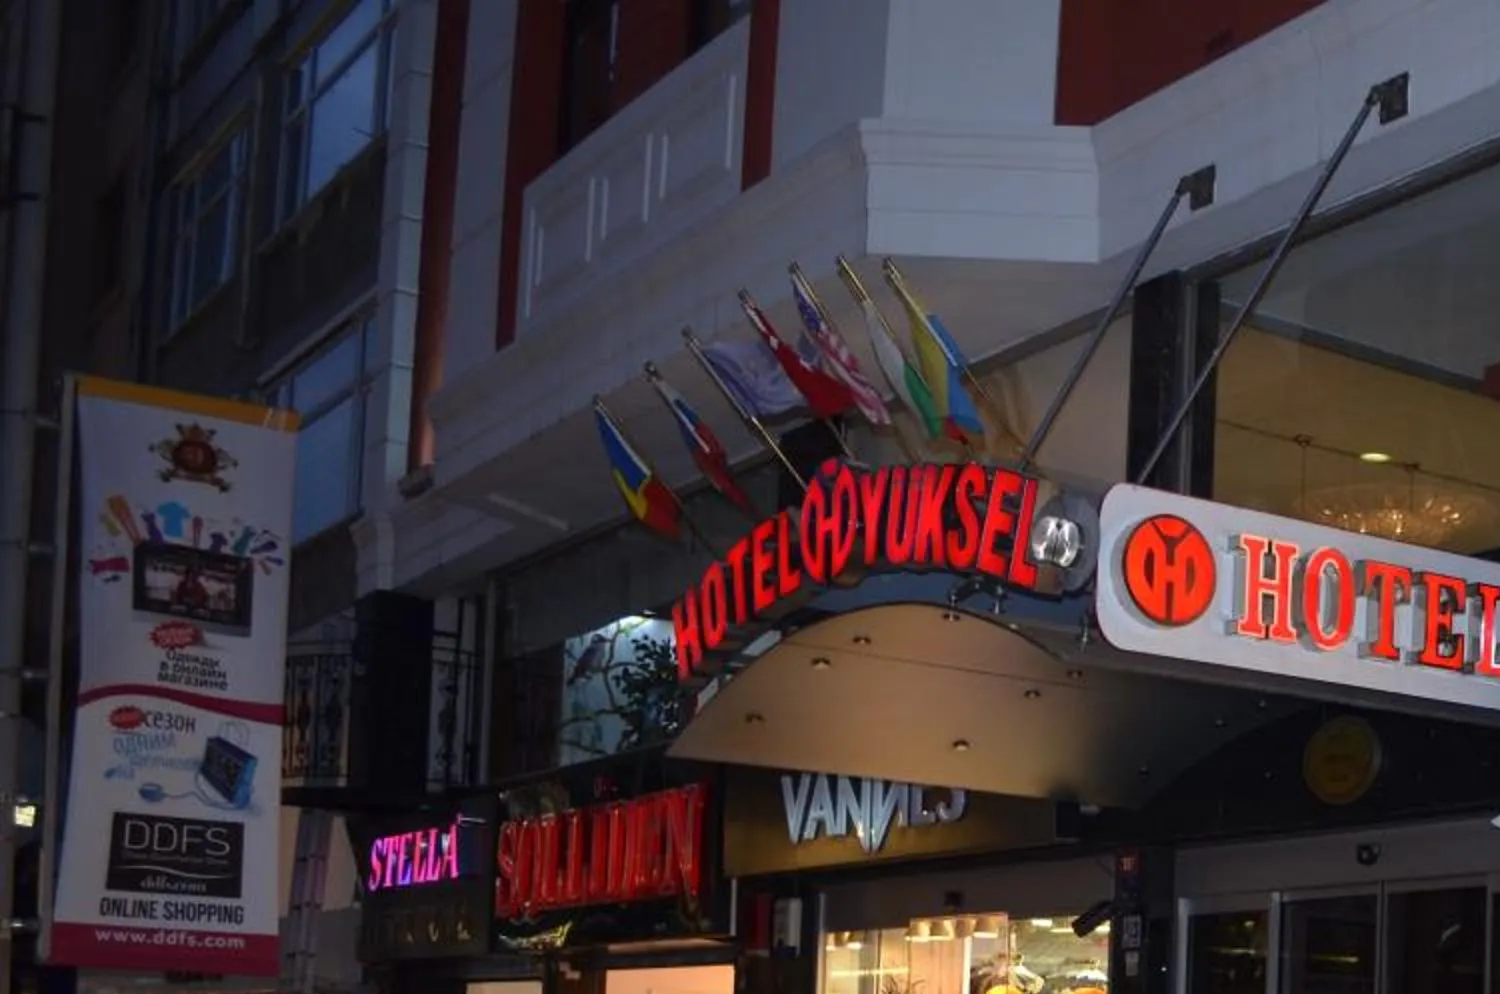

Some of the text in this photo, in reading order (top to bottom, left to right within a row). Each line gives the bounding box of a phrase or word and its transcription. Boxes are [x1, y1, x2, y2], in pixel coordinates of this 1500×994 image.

[671, 462, 1039, 681] HOTEL YÜKSEL
[123, 819, 231, 856] DDFS
[368, 821, 460, 894] STELLA
[100, 897, 244, 925] ONLINE SHOPPING
[95, 928, 245, 948] www.ddfs.com
